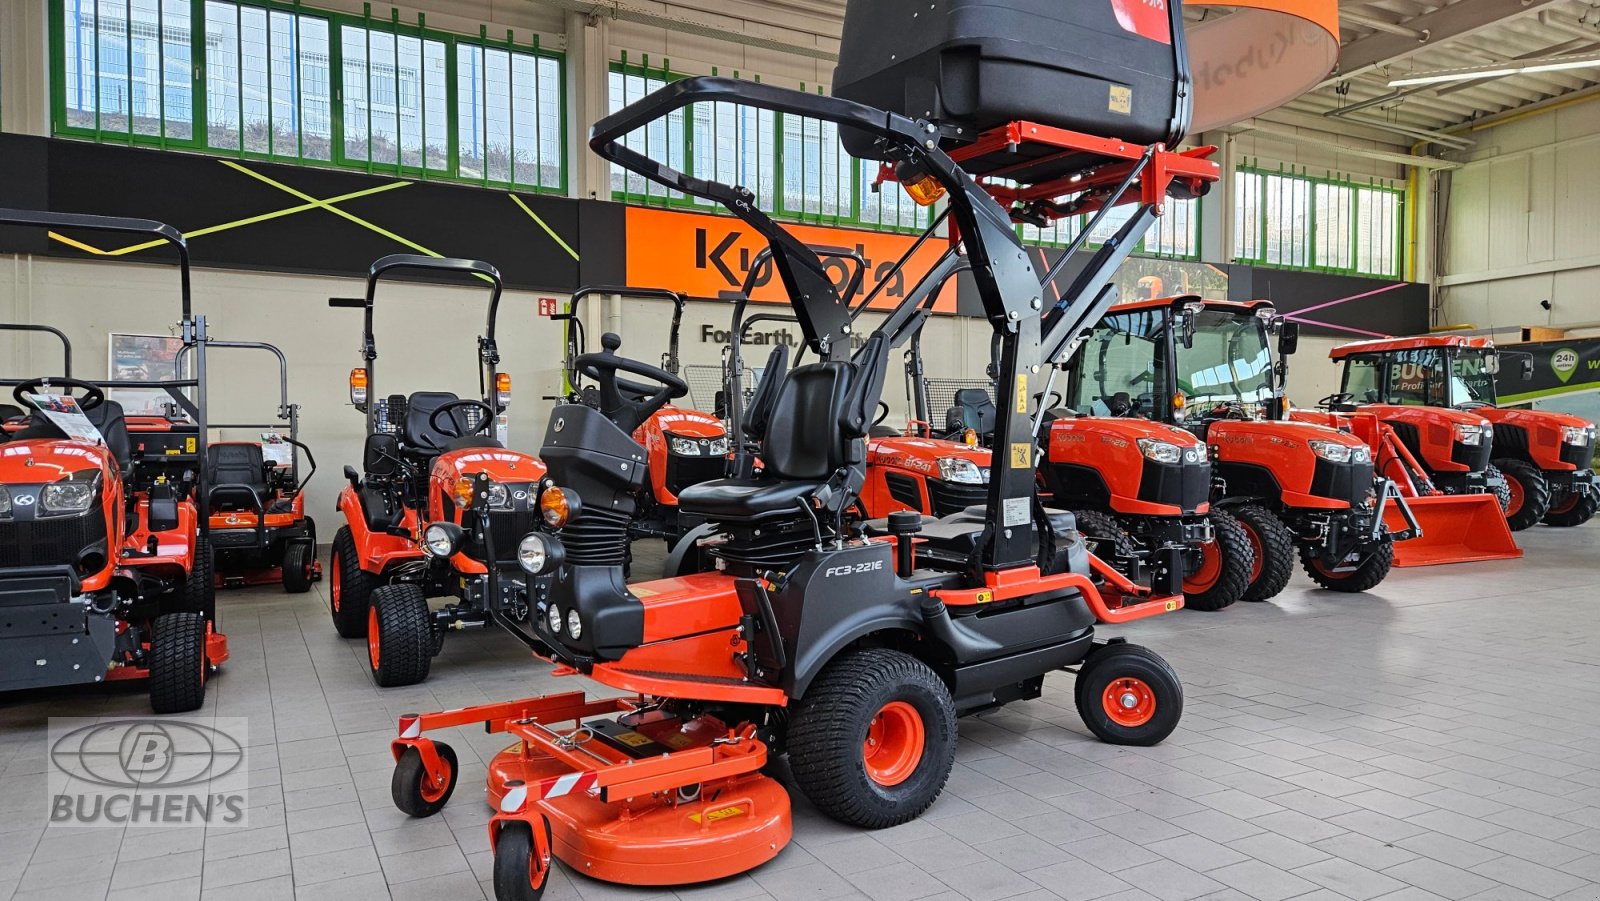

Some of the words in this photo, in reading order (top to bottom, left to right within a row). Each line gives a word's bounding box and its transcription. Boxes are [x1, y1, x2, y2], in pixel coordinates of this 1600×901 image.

[695, 228, 904, 297] Kuota
[1556, 353, 1574, 363] 24h
[1401, 381, 1423, 390] Profi
[825, 560, 883, 577] FC3-221E
